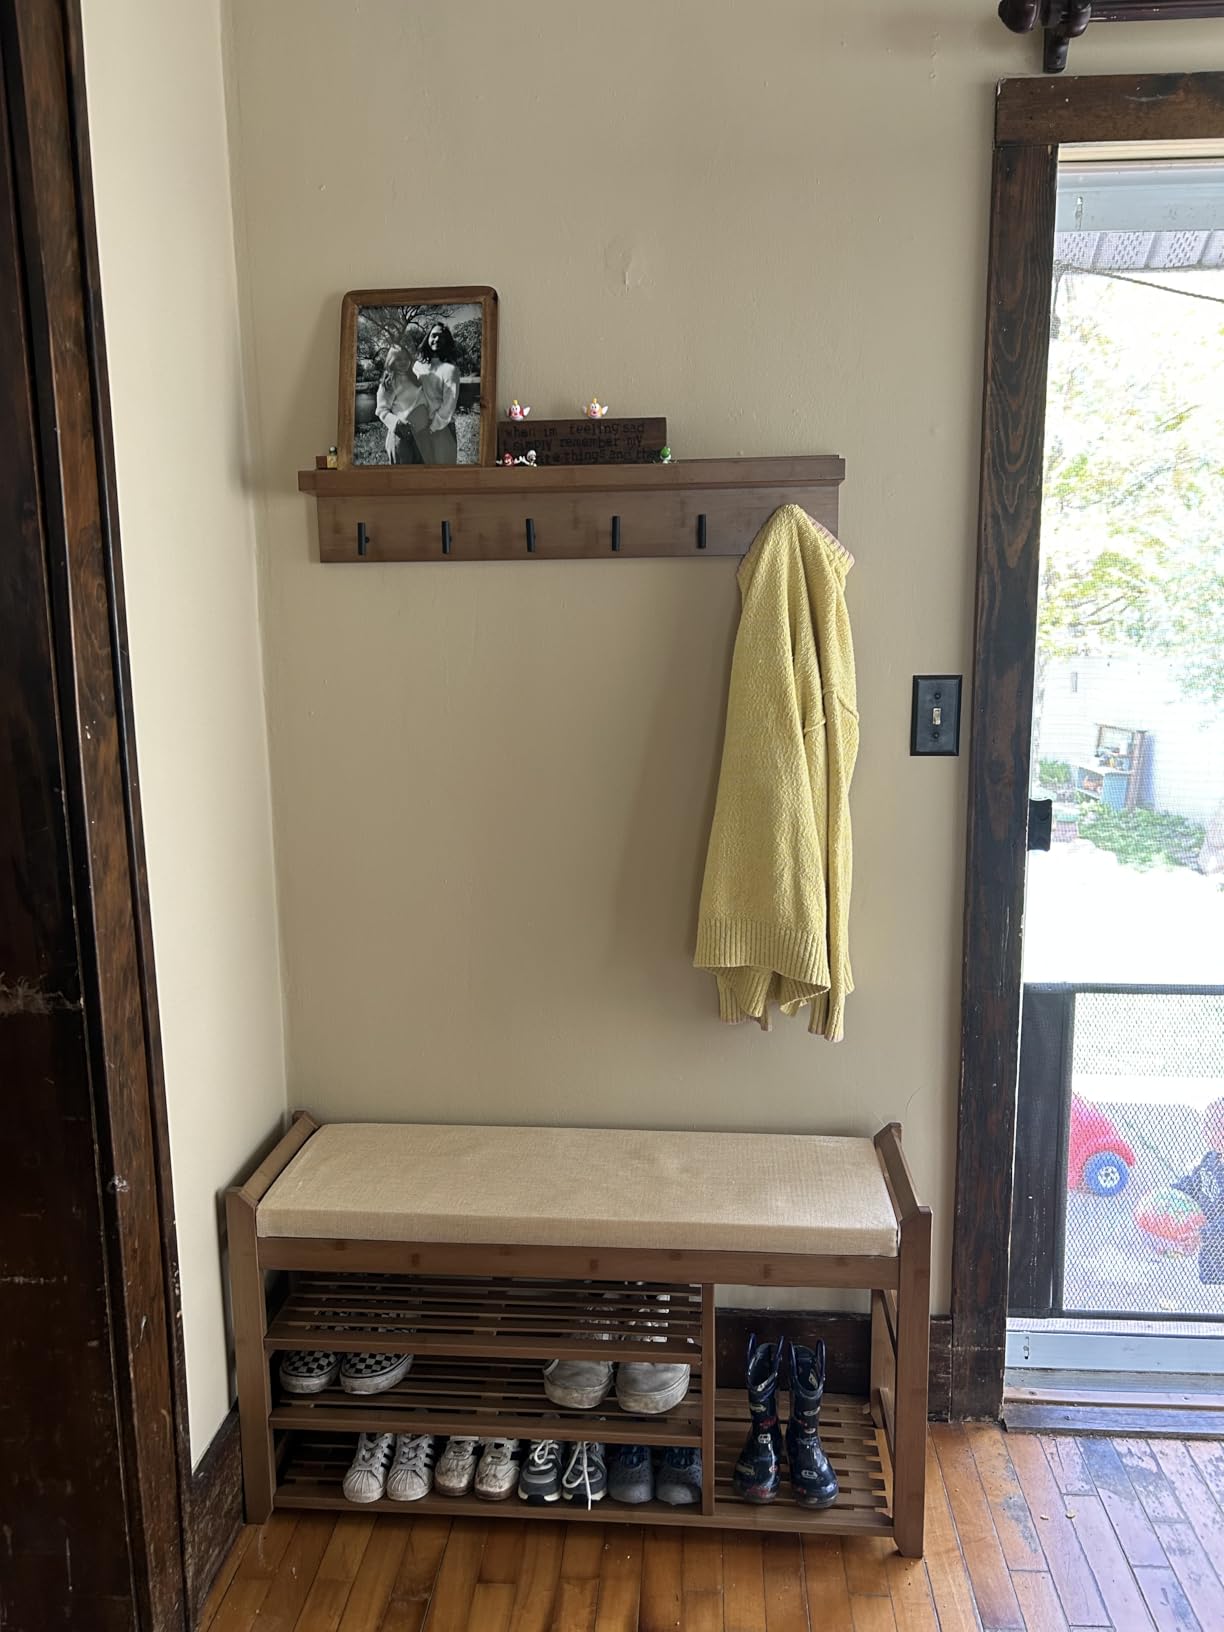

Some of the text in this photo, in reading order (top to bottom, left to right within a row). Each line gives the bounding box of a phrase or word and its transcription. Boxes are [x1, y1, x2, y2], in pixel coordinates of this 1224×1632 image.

[568, 422, 620, 436] feeling
[622, 423, 645, 434] sad
[559, 437, 621, 449] remember
[625, 434, 643, 449] my
